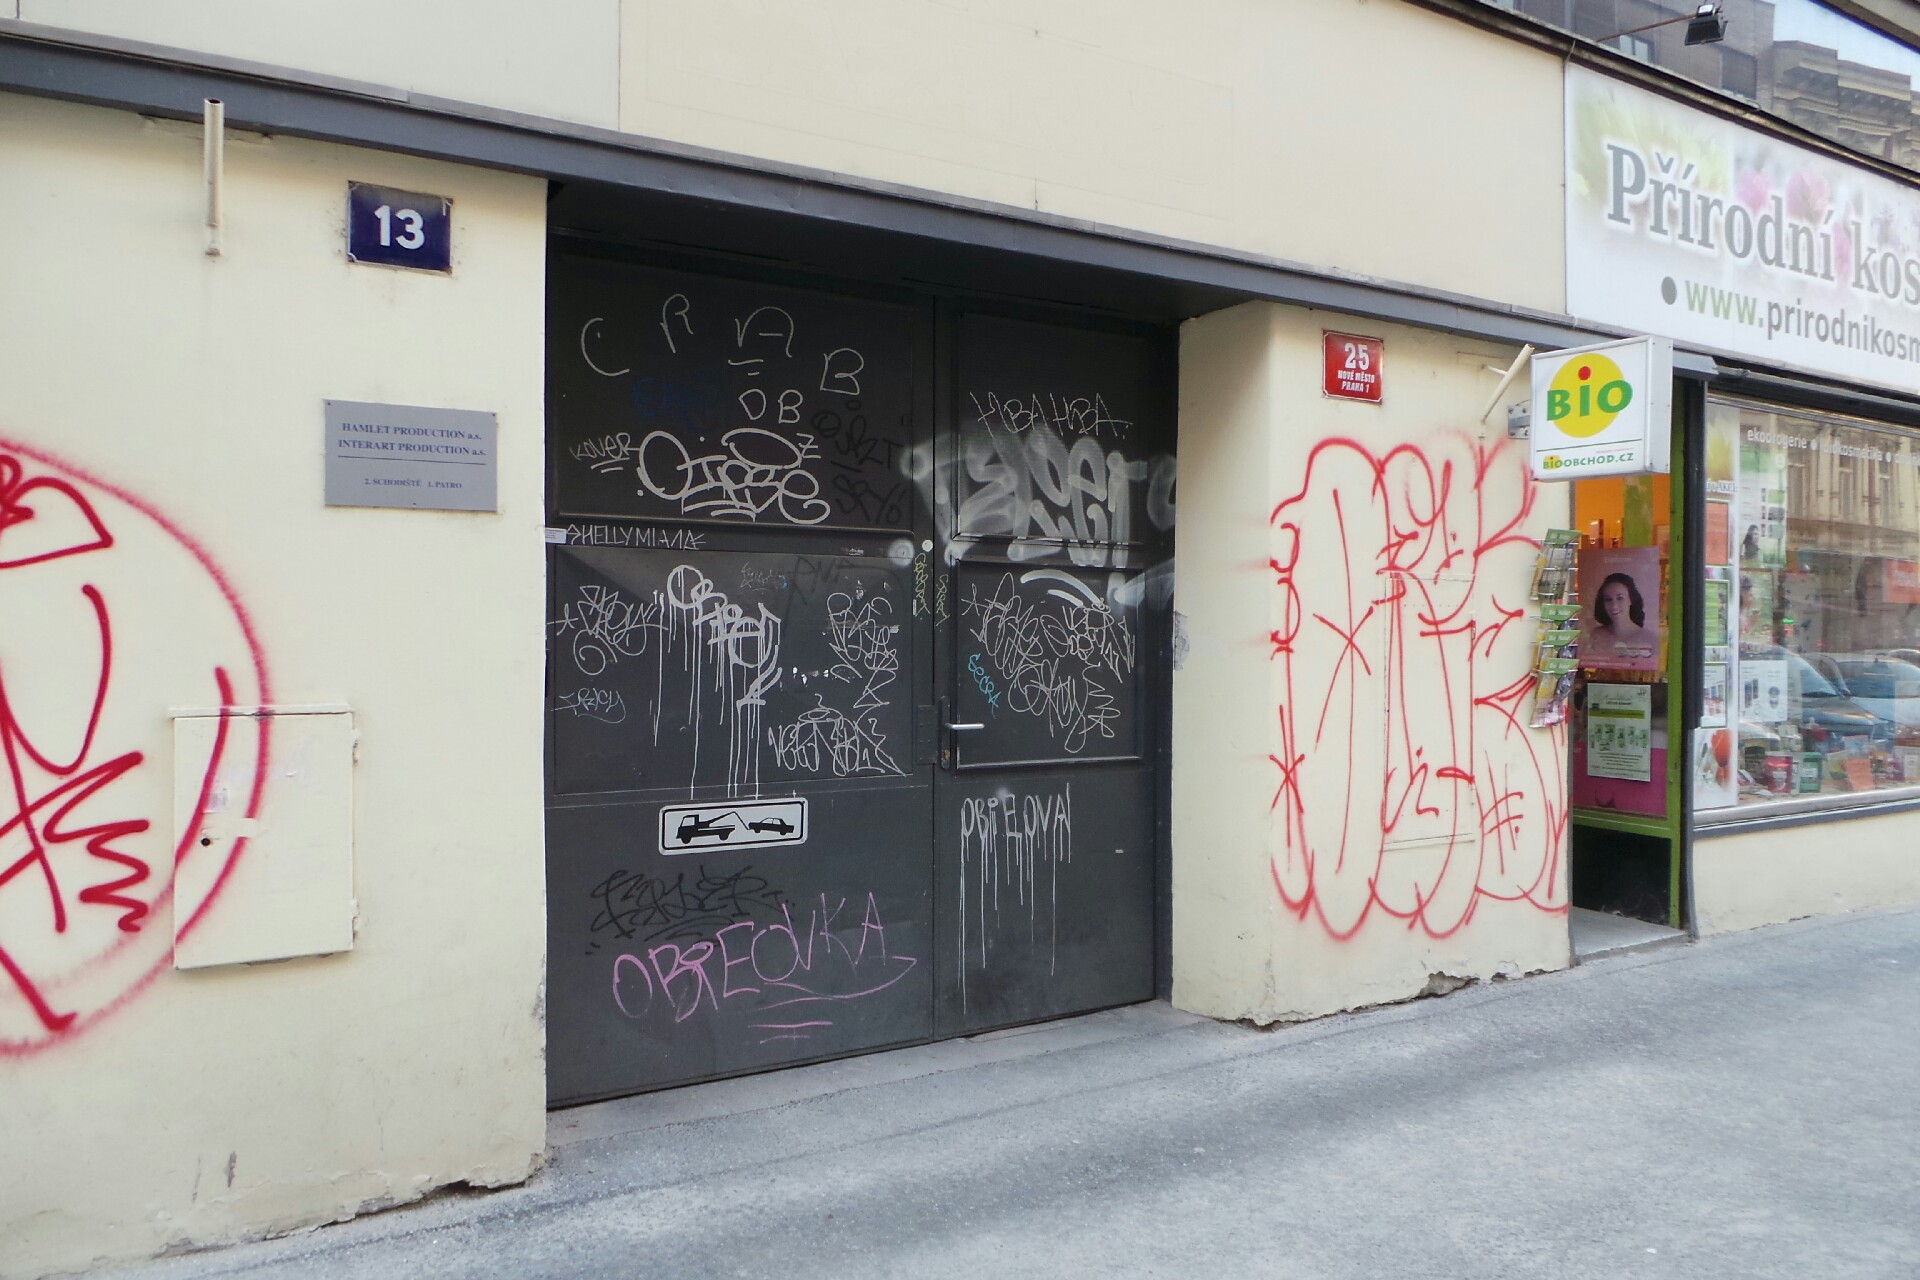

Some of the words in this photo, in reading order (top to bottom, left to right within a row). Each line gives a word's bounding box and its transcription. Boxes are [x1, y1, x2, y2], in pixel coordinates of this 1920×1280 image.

[1607, 144, 1835, 282] Přírodní
[374, 205, 425, 249] 13
[1344, 342, 1370, 371] 25
[1337, 370, 1355, 381] NOVÉ
[1355, 372, 1375, 383] MĚSTO
[1341, 381, 1364, 393] PRAHA
[1365, 384, 1370, 393] 1
[342, 422, 391, 434] HAMLET
[394, 426, 465, 439] PRODUCTION
[467, 432, 482, 440] a.s.
[338, 439, 396, 451] INTERART
[399, 442, 470, 455] PRODUCTION
[472, 448, 487, 456] a.s.
